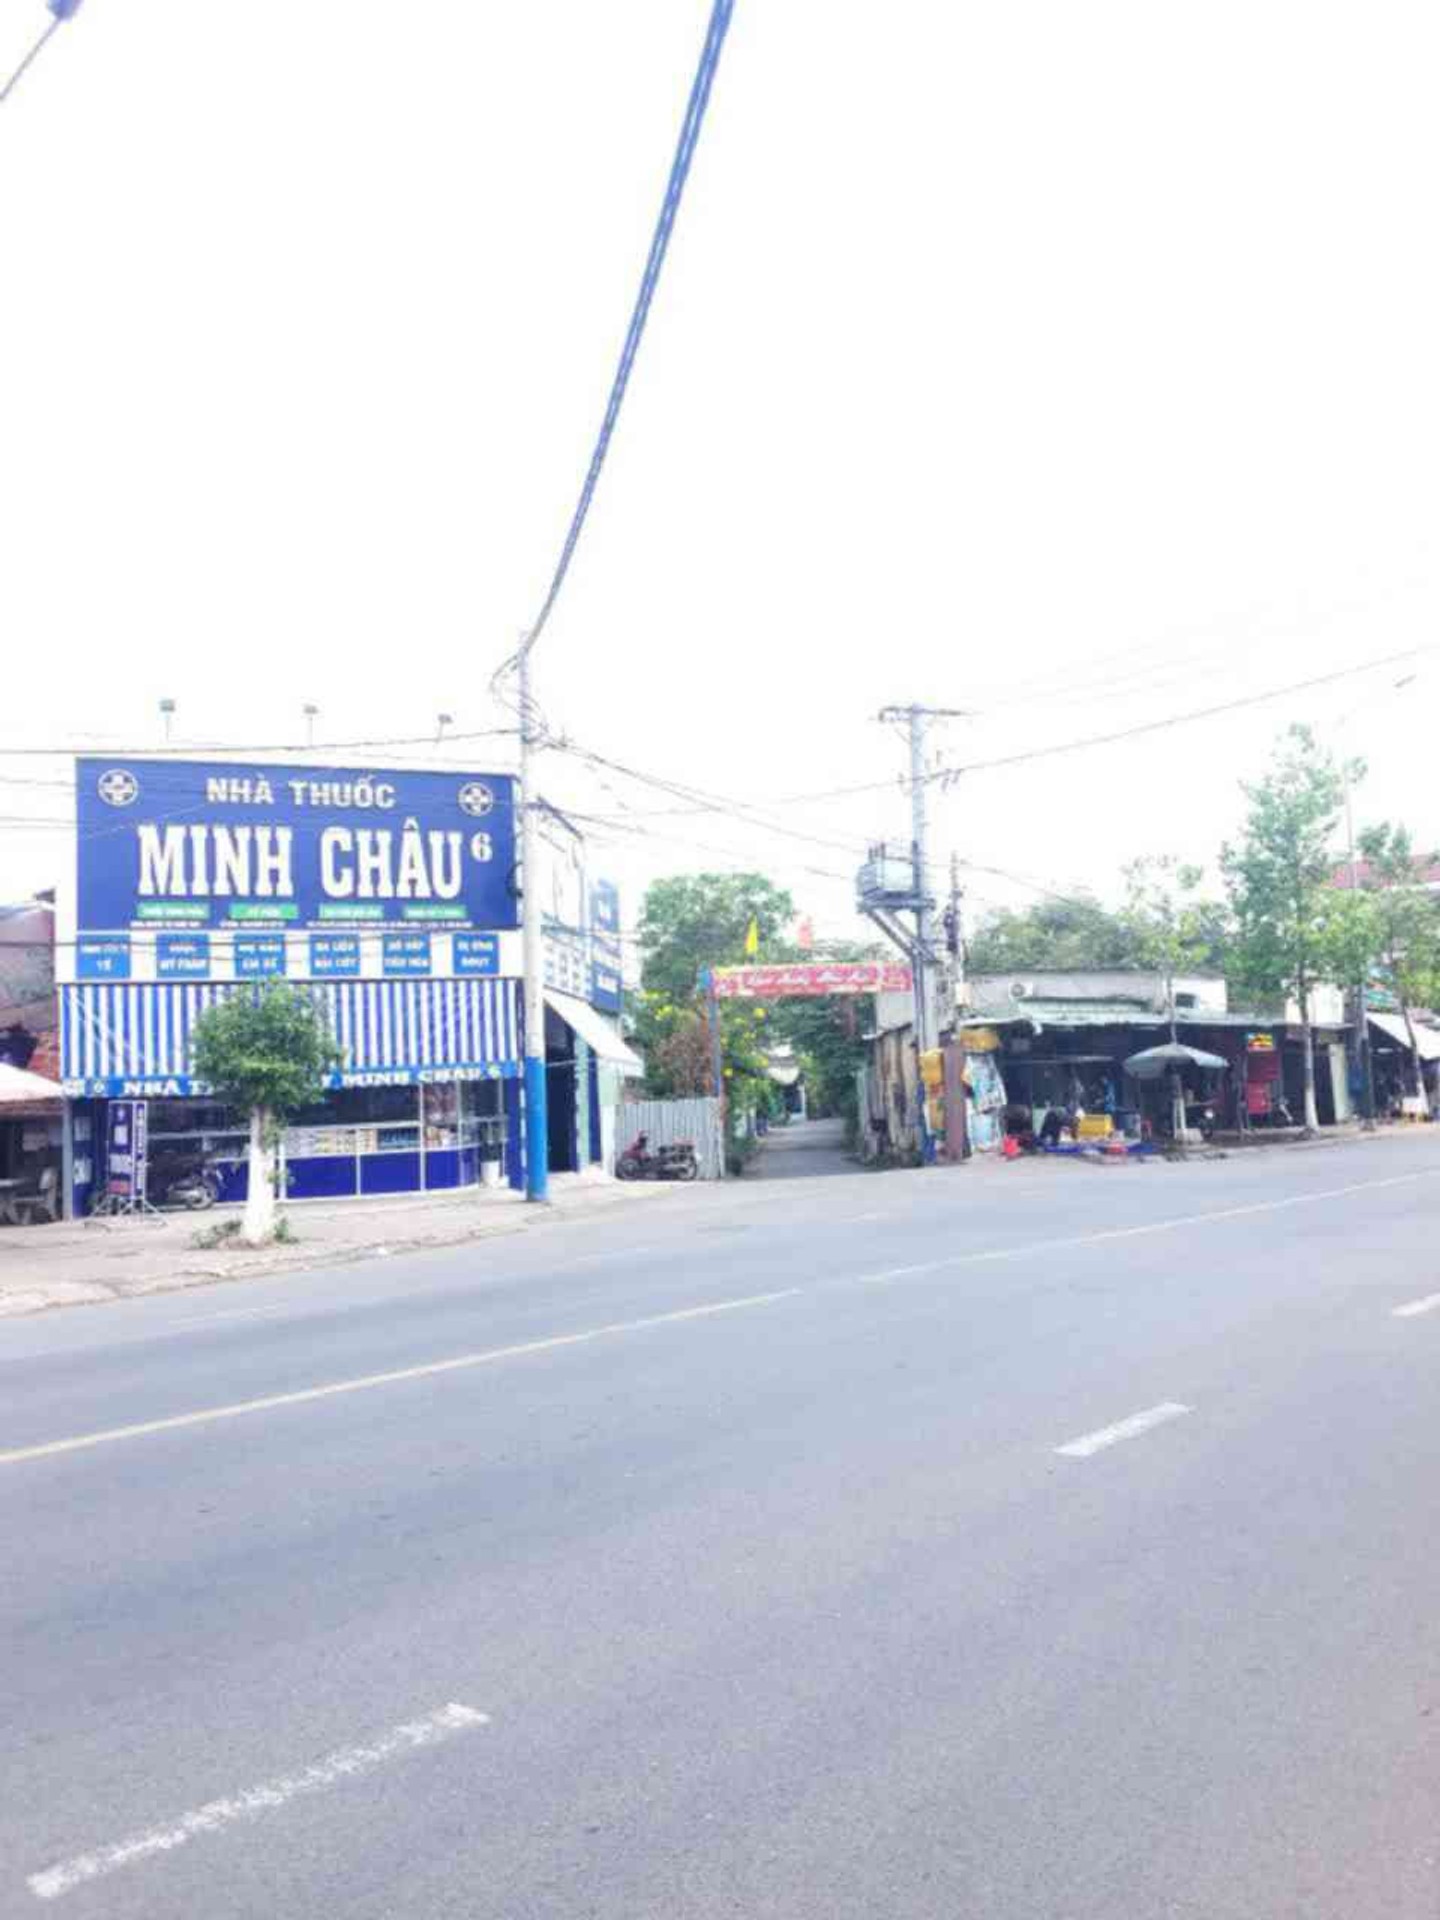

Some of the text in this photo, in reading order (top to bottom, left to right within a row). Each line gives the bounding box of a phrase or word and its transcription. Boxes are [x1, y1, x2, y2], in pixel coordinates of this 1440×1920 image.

[206, 772, 396, 809] NHÀ THUỐC
[137, 816, 493, 898] MINH CHÂU 6
